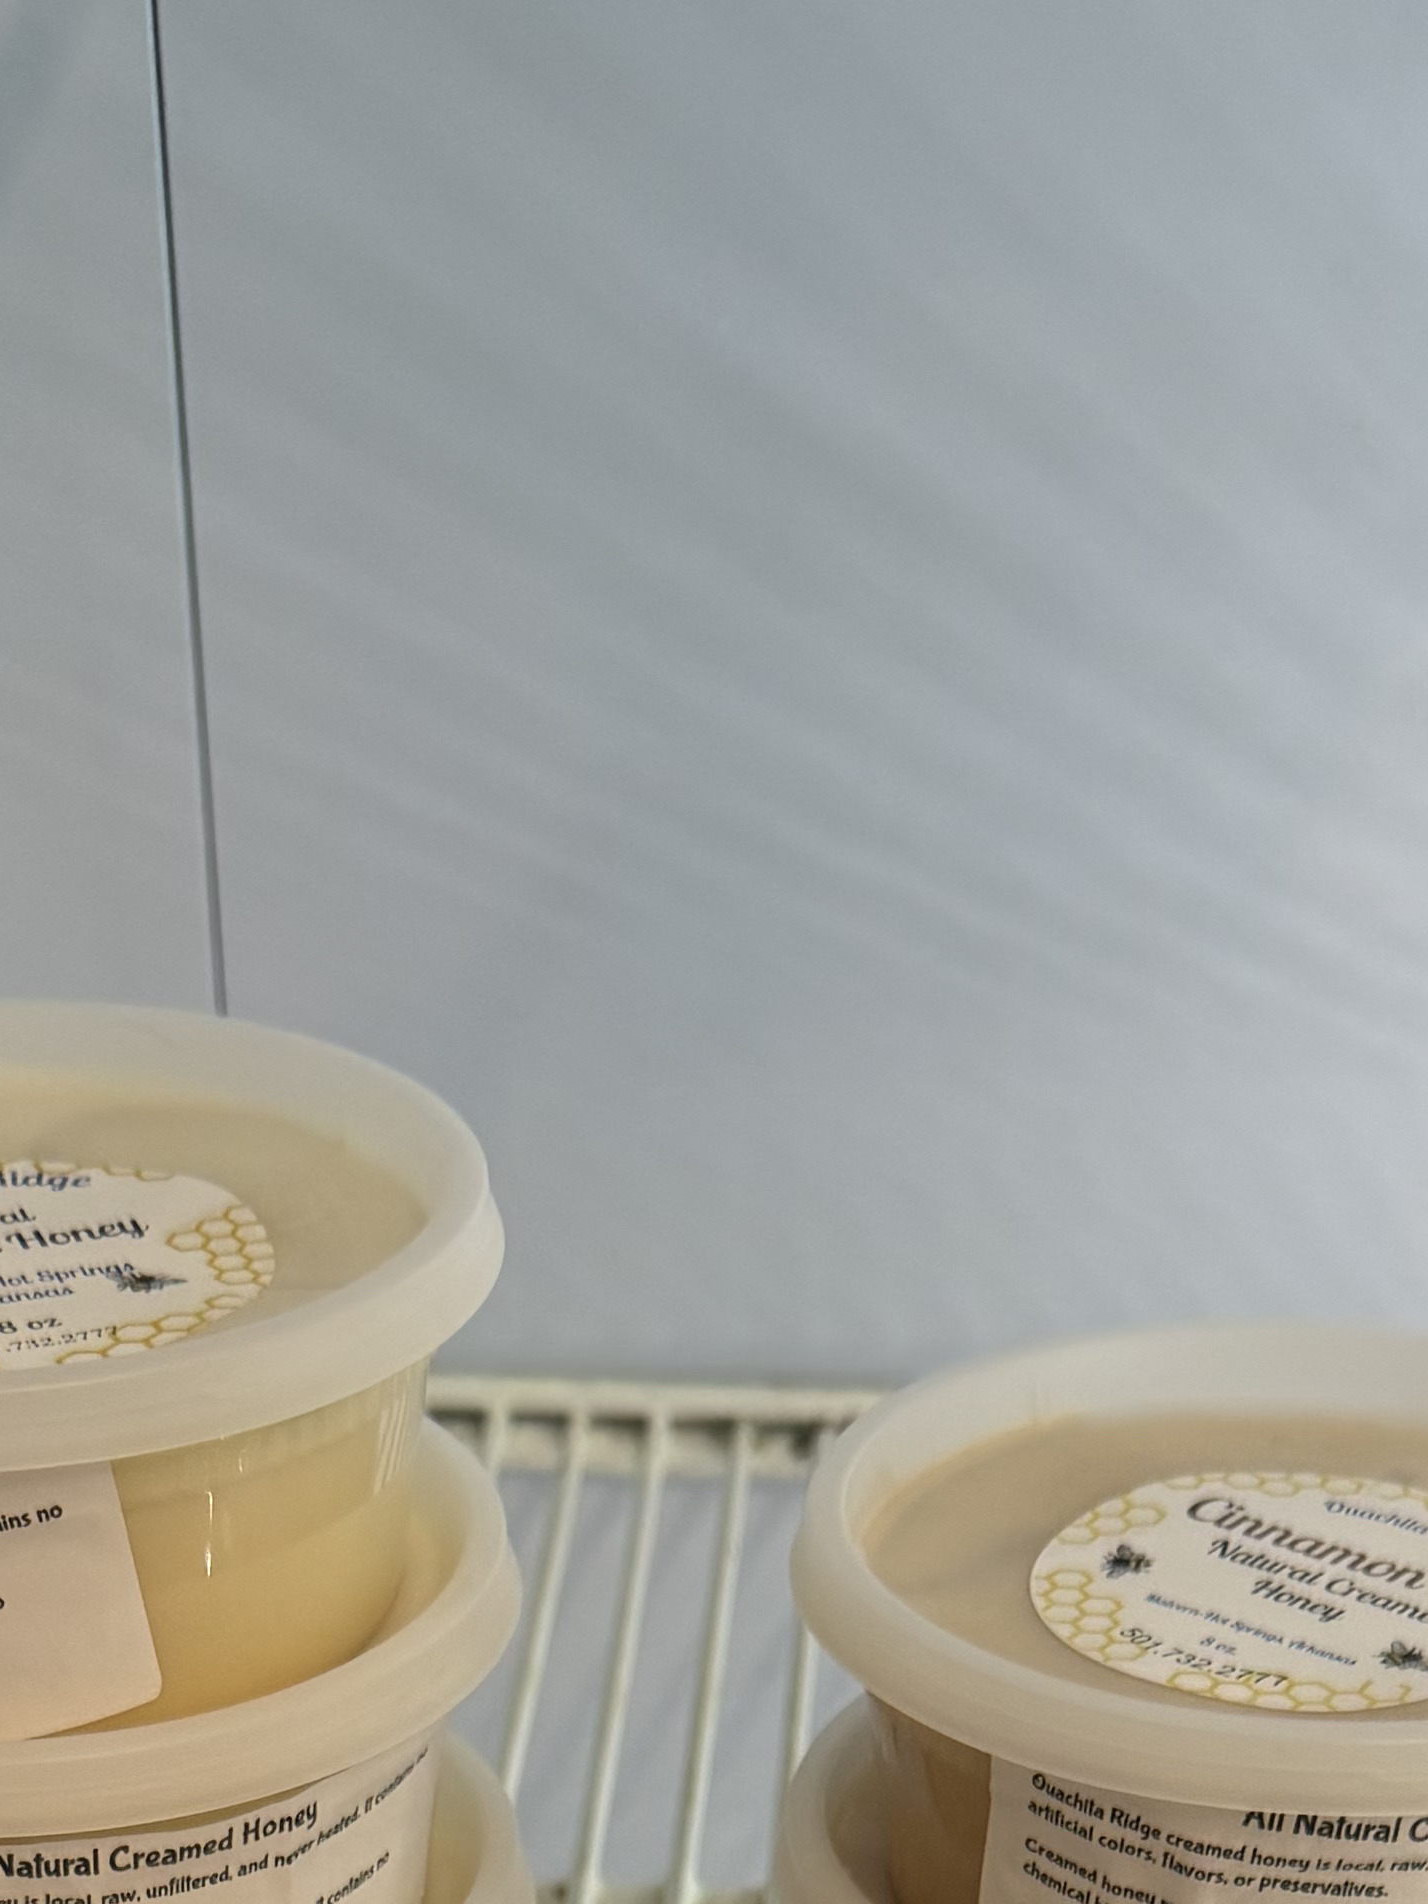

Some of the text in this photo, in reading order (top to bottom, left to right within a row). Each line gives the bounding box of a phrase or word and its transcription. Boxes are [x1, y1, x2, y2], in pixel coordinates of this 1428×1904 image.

[6, 1216, 149, 1249] Honey
[37, 1261, 136, 1286] Springs
[27, 1317, 63, 1331] oz
[37, 1503, 63, 1522] no
[1187, 1496, 1424, 1591] Cinnamon
[1210, 1538, 1320, 1585] Natural
[1251, 1578, 1346, 1623] Honey
[1120, 1626, 1288, 1688] 501.732.2777
[1199, 1636, 1213, 1648] 8
[108, 1828, 234, 1871] Creamed
[242, 1800, 319, 1845] Honey
[1293, 1813, 1401, 1843] Natural
[1024, 1838, 1098, 1881] Creamed
